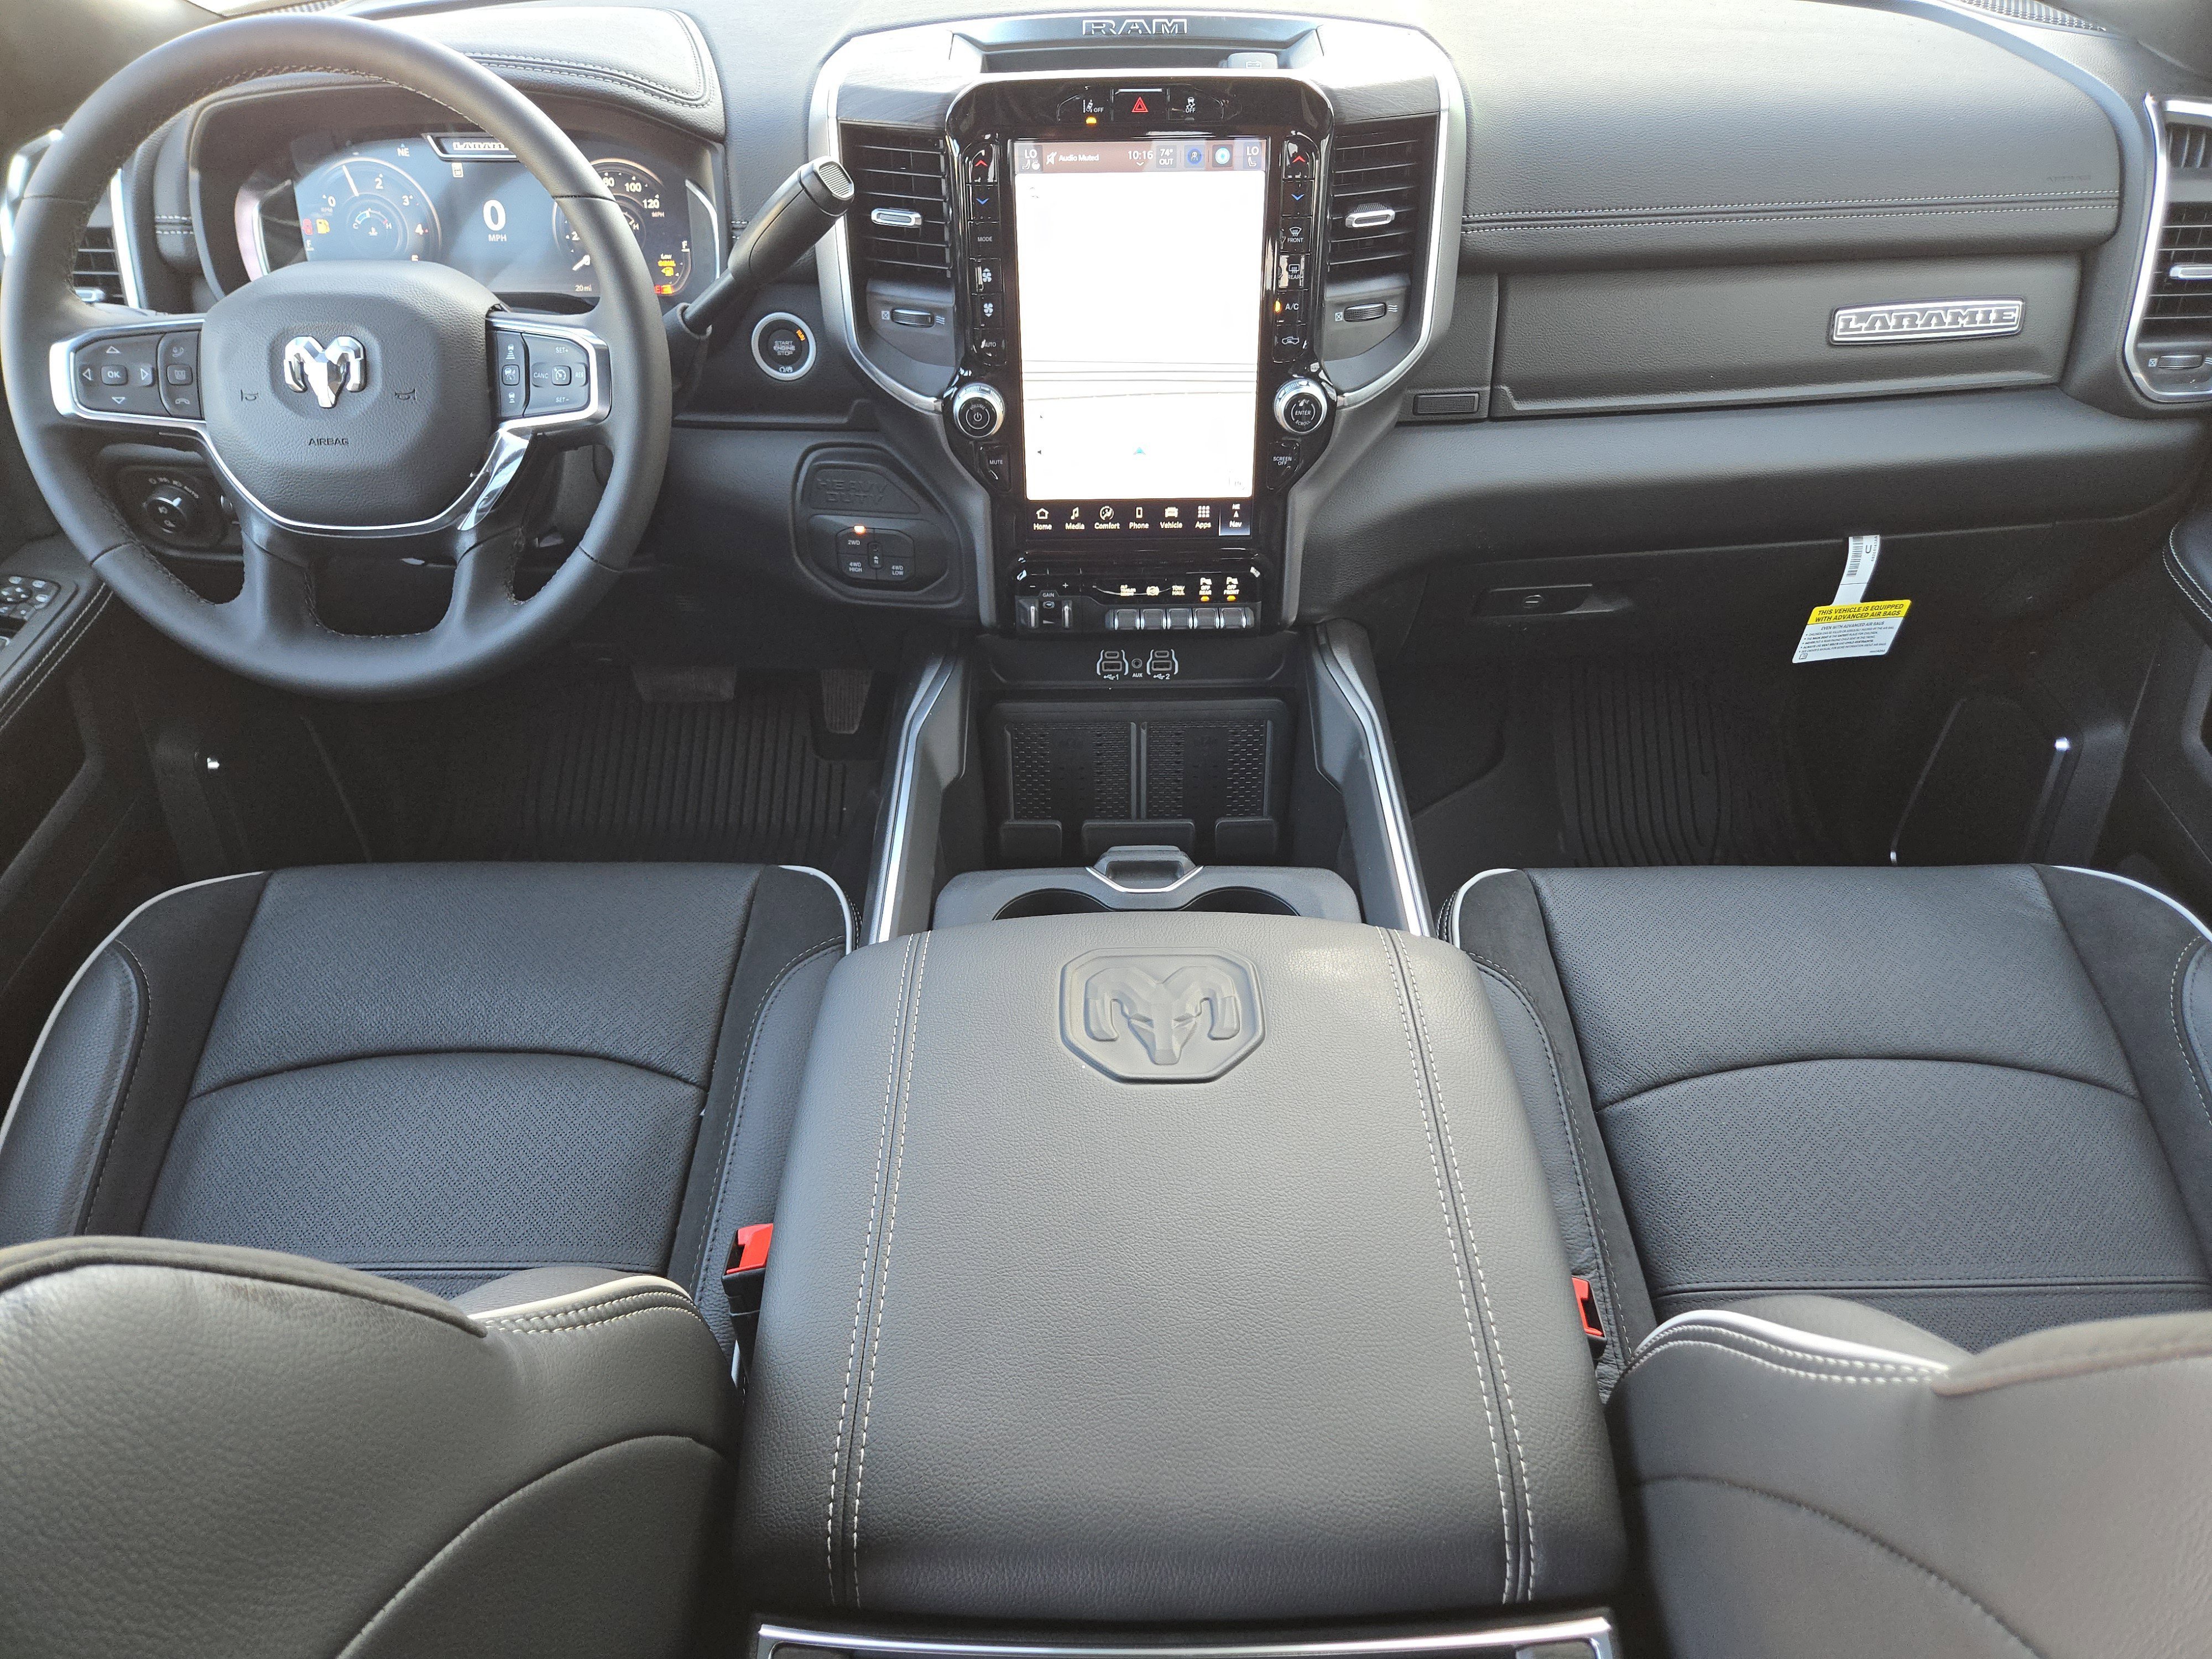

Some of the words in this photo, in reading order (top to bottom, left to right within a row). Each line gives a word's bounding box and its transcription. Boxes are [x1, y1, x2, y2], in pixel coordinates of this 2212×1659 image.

[1082, 19, 1187, 35] RAM
[453, 142, 509, 150] LARAM
[1246, 146, 1259, 155] LO
[397, 148, 410, 156] NE
[1024, 149, 1037, 159] LO
[1128, 150, 1154, 160] 10:16
[375, 178, 383, 189] 2
[625, 182, 641, 192] 100
[328, 196, 336, 207] 0
[402, 195, 409, 206] 3
[643, 199, 659, 208] 120
[483, 200, 505, 231] 0
[415, 224, 424, 235] 4
[572, 231, 580, 241] 2
[1837, 306, 2018, 335] LARAMIE
[1866, 545, 1872, 554] U
